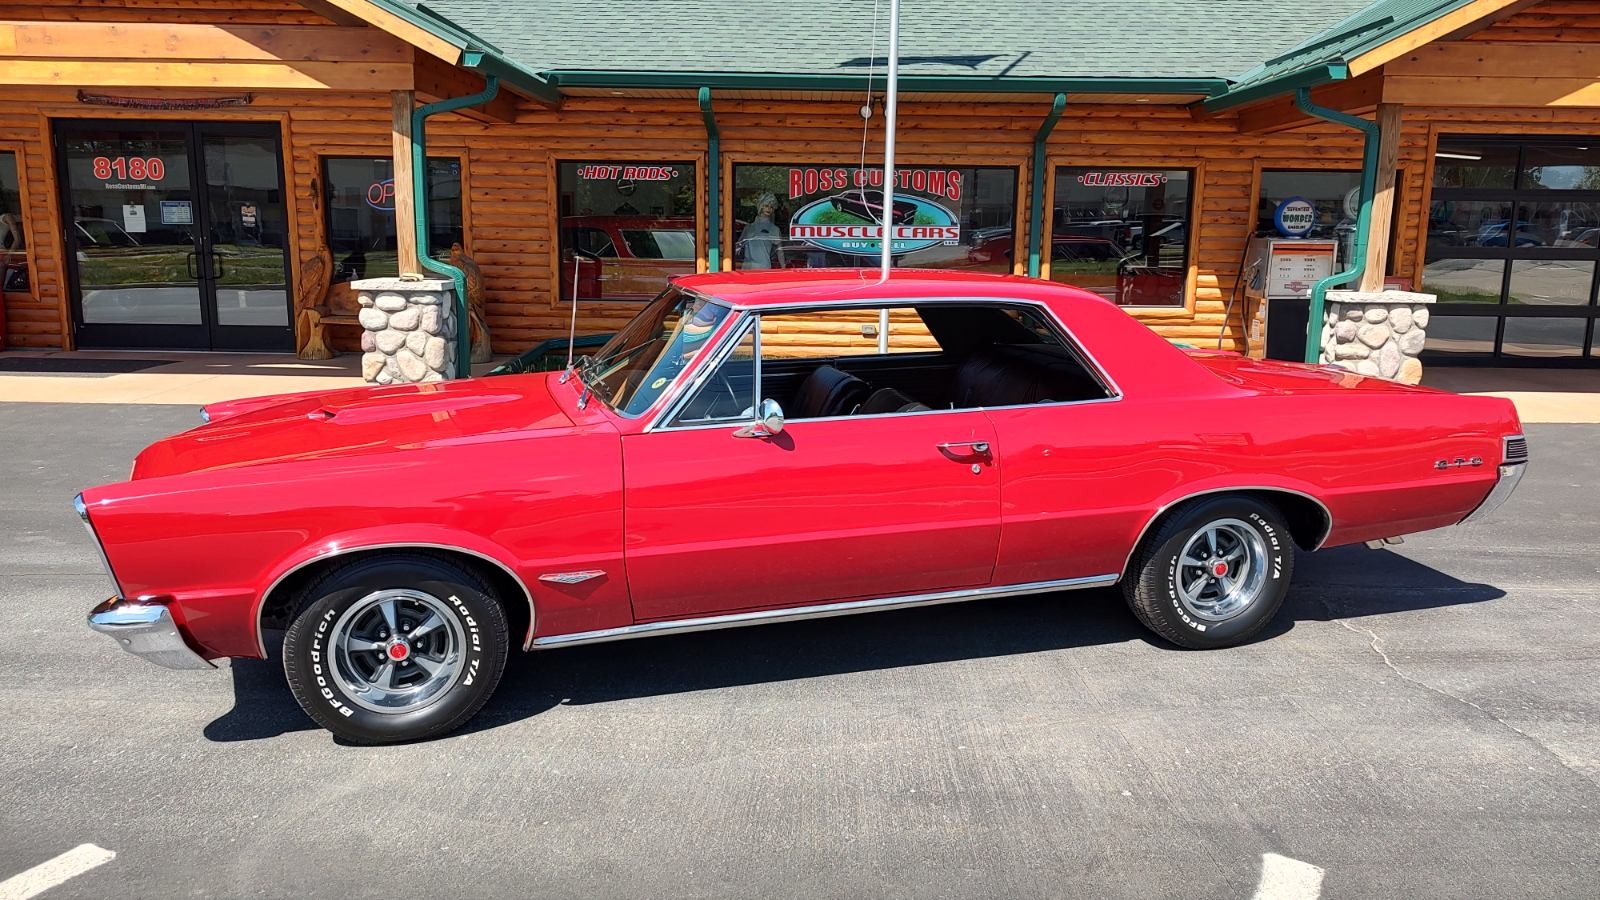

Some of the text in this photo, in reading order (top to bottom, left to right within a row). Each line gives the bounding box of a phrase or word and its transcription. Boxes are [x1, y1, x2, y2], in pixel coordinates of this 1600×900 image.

[93, 156, 165, 181] 8180
[583, 165, 673, 181] HOT RODS
[1083, 172, 1162, 187] CLASSICS
[367, 183, 396, 204] OP
[789, 168, 848, 199] ROSS
[1282, 214, 1313, 223] WONDER
[897, 226, 959, 239] CARS
[1249, 512, 1283, 580] Radial T/A
[1167, 555, 1207, 632] BFGoodrich
[447, 594, 482, 687] Radial T/A
[310, 608, 355, 718] BFGoodrich
